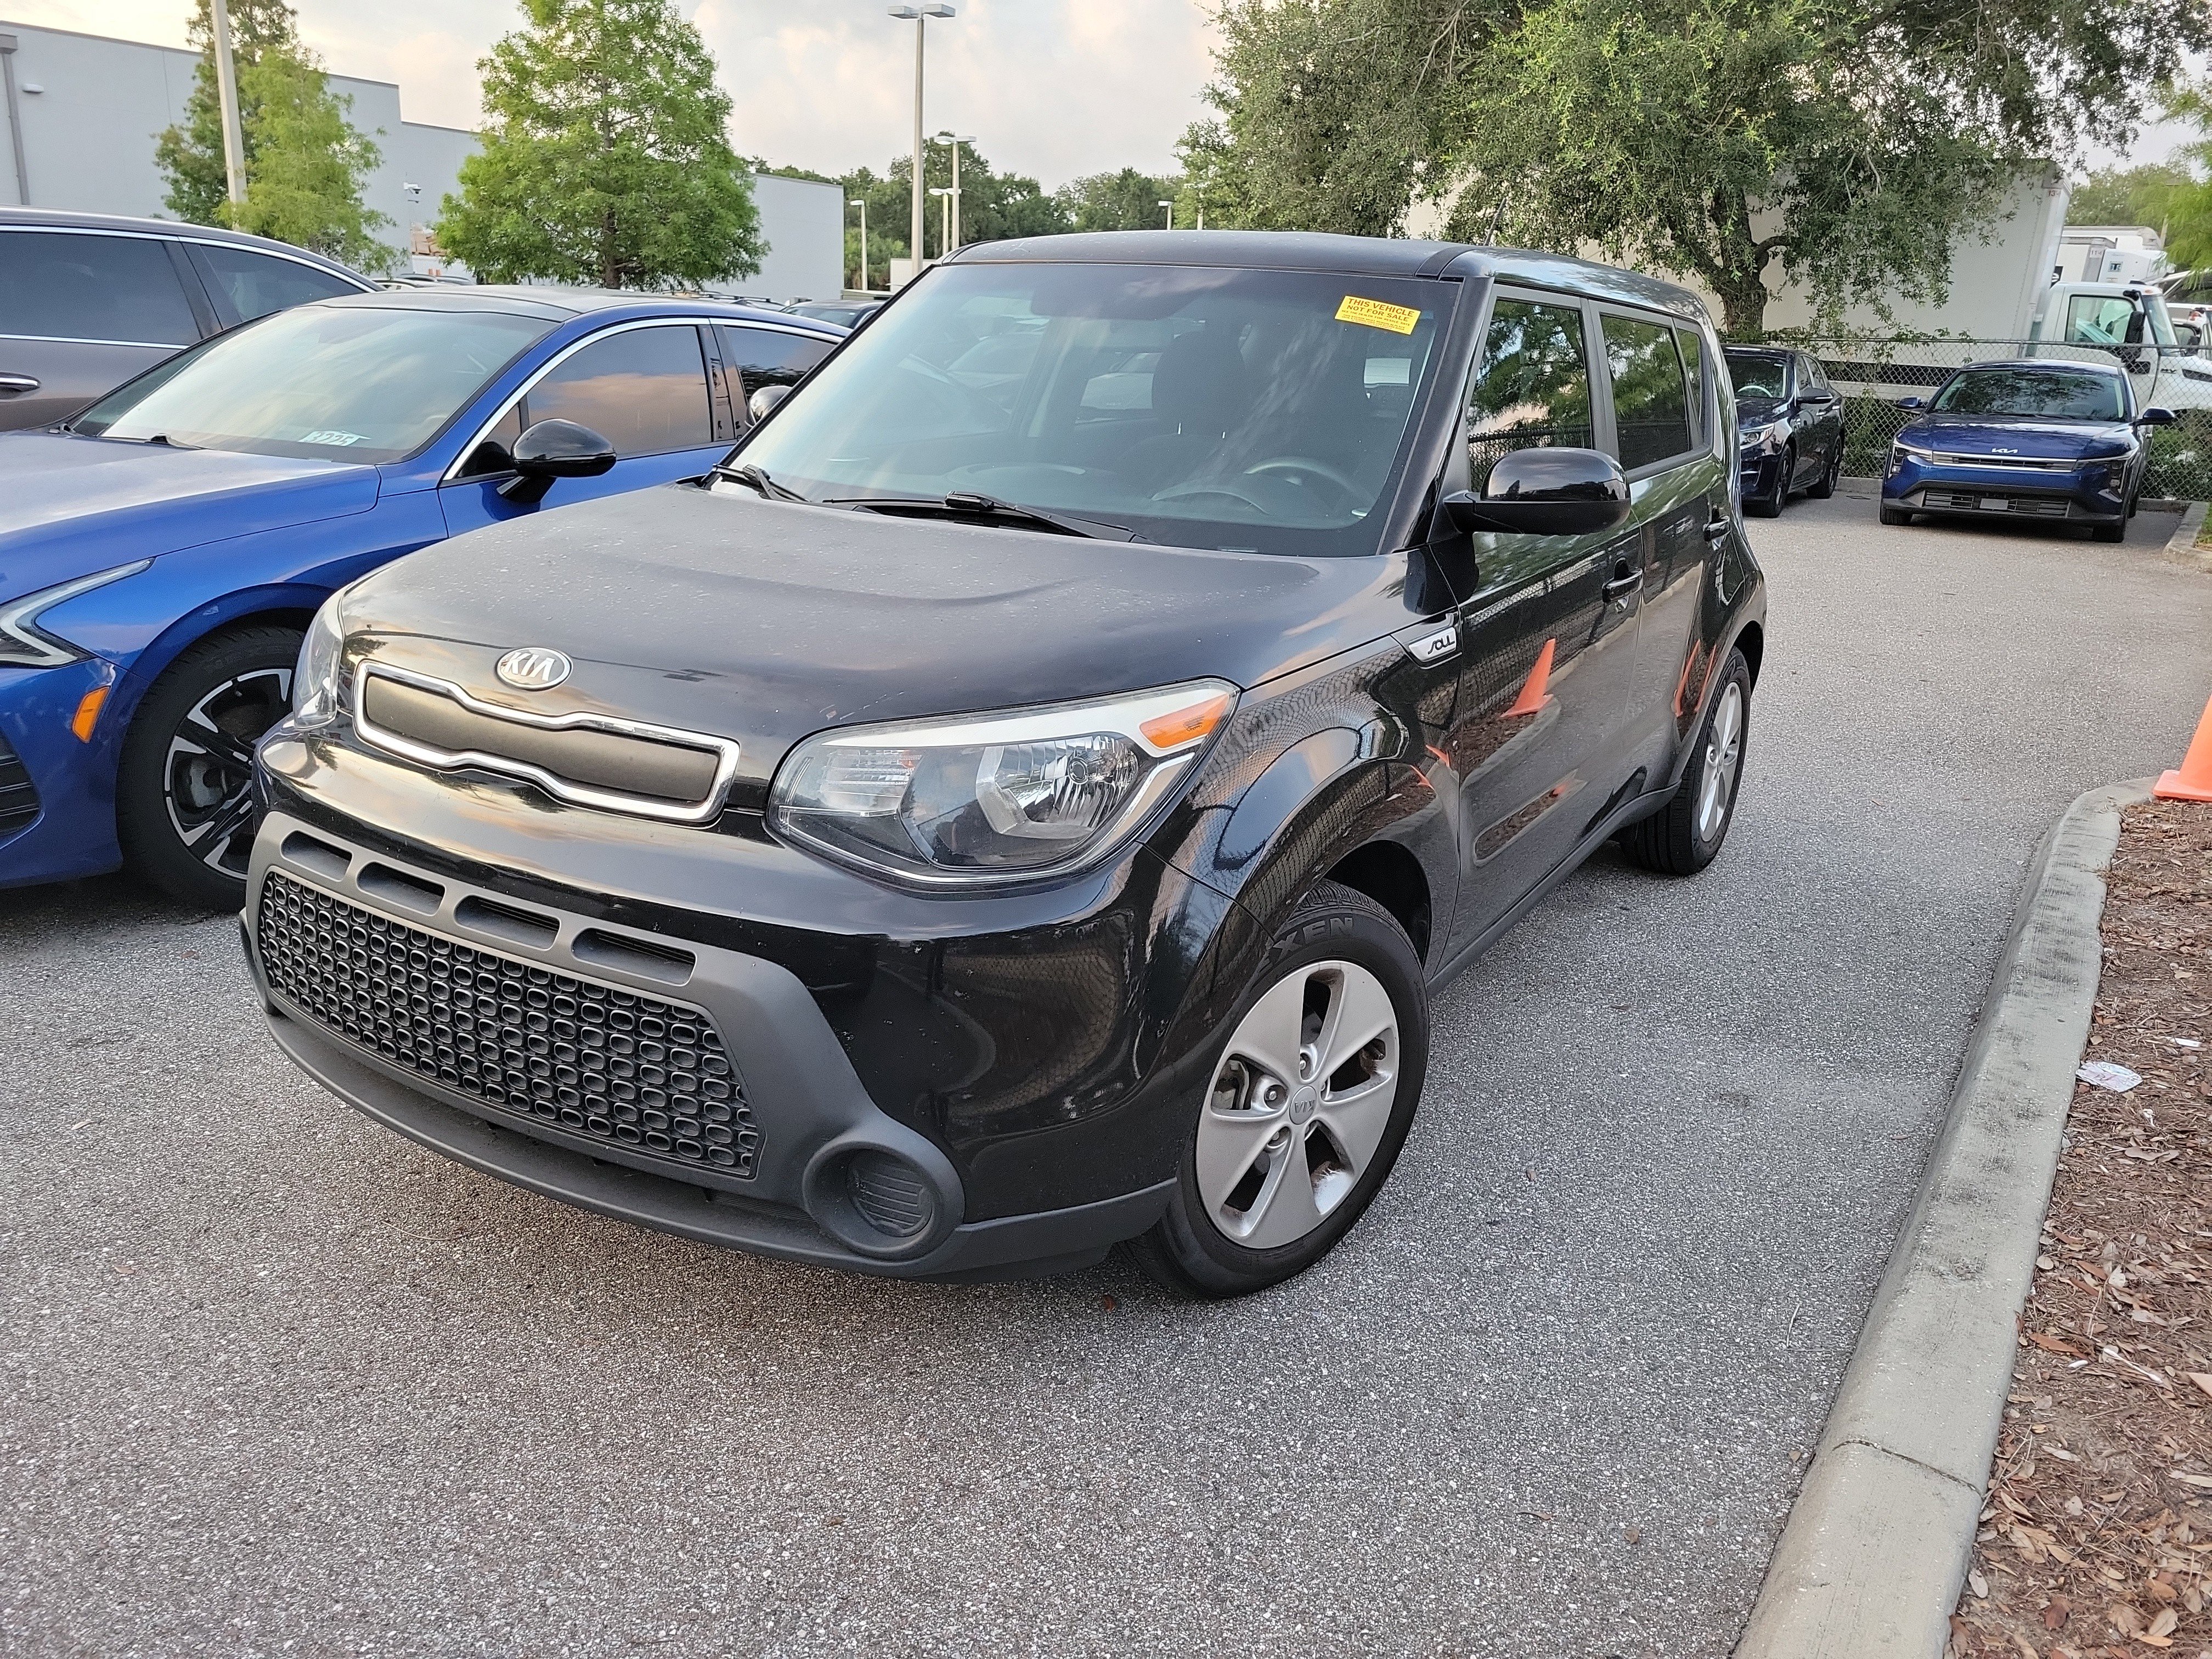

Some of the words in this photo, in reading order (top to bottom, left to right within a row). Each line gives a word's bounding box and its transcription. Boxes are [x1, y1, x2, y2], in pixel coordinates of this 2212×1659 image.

[1348, 298, 1370, 307] THIS
[1373, 302, 1415, 317] VEHICLE
[1386, 313, 1409, 321] SALE
[503, 652, 555, 681] KIA
[1295, 1099, 1316, 1114] KIA
